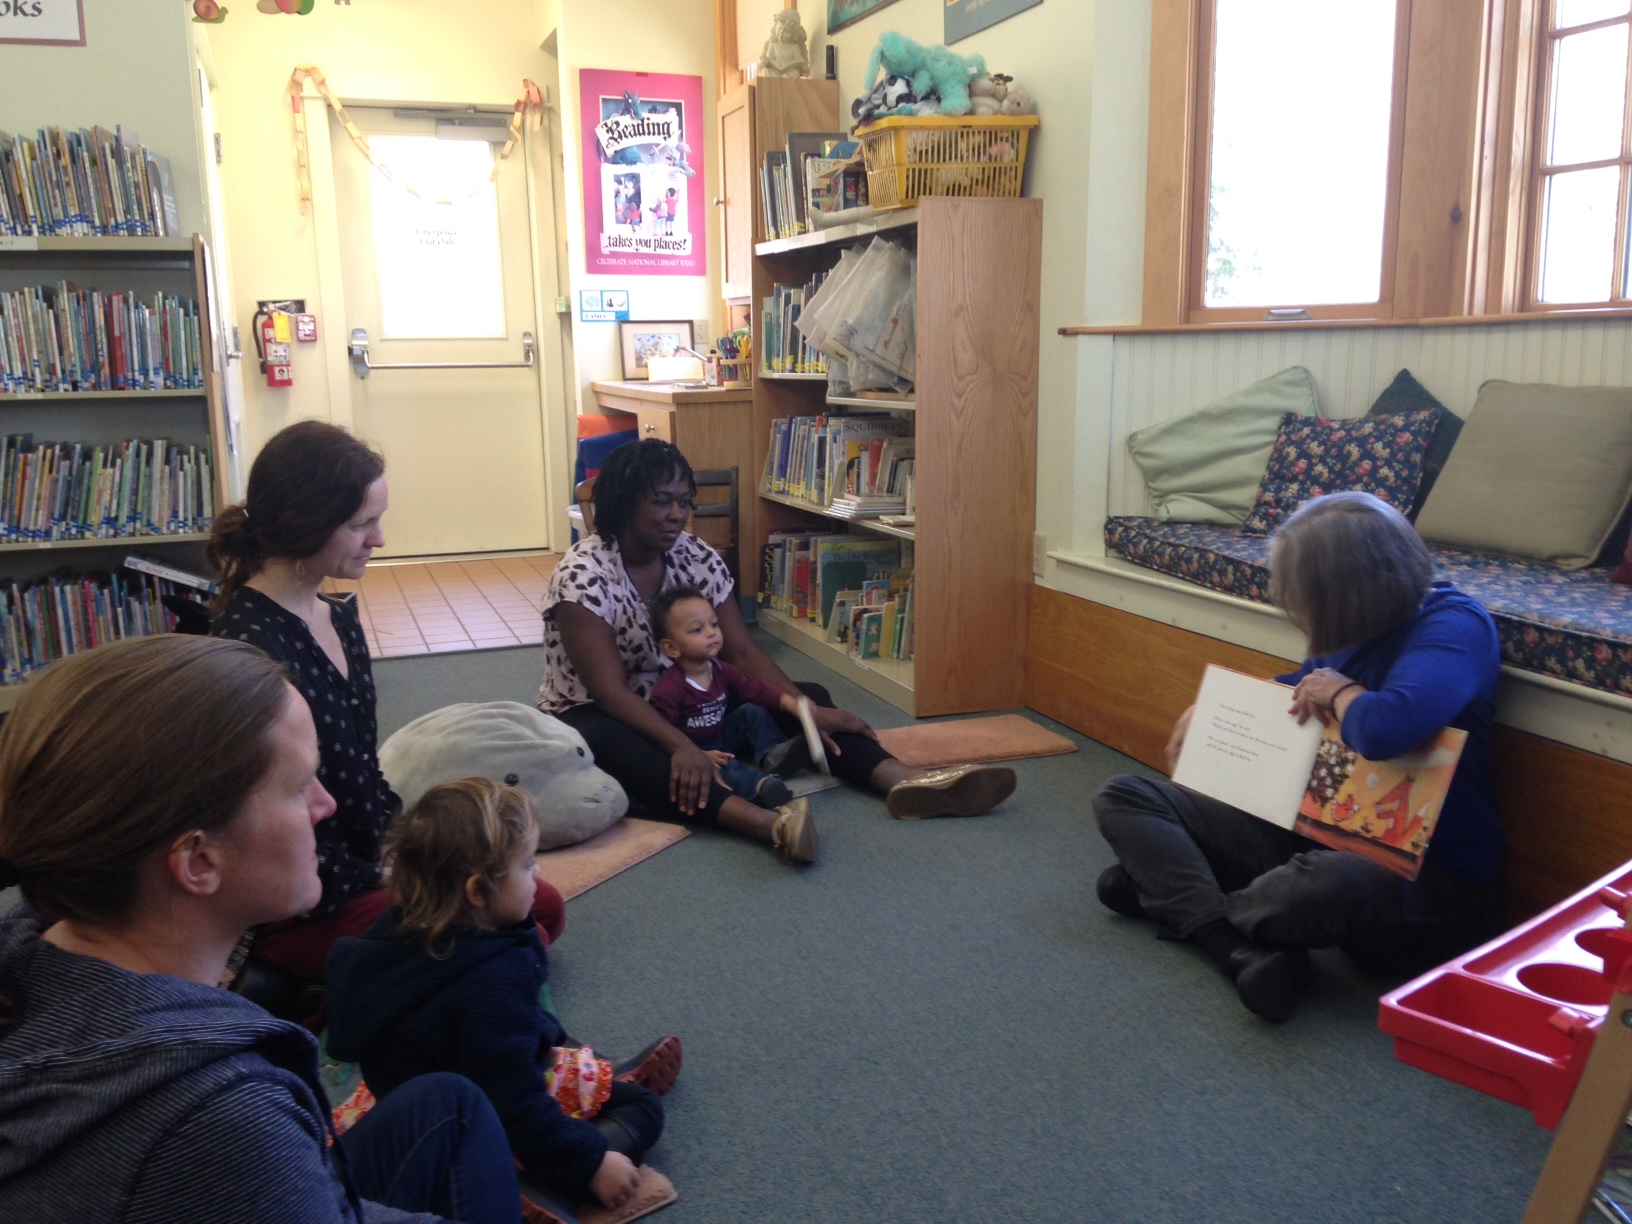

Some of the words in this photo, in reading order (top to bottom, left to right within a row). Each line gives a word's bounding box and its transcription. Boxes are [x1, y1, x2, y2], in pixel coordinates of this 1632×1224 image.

[601, 117, 675, 149] Reading
[634, 238, 652, 252] you
[653, 237, 688, 252] places!
[596, 257, 627, 266] CELEBRATE
[628, 258, 657, 267] NATIONAL
[657, 259, 679, 267] LIBRARY
[845, 422, 904, 433] SQUIRRELS
